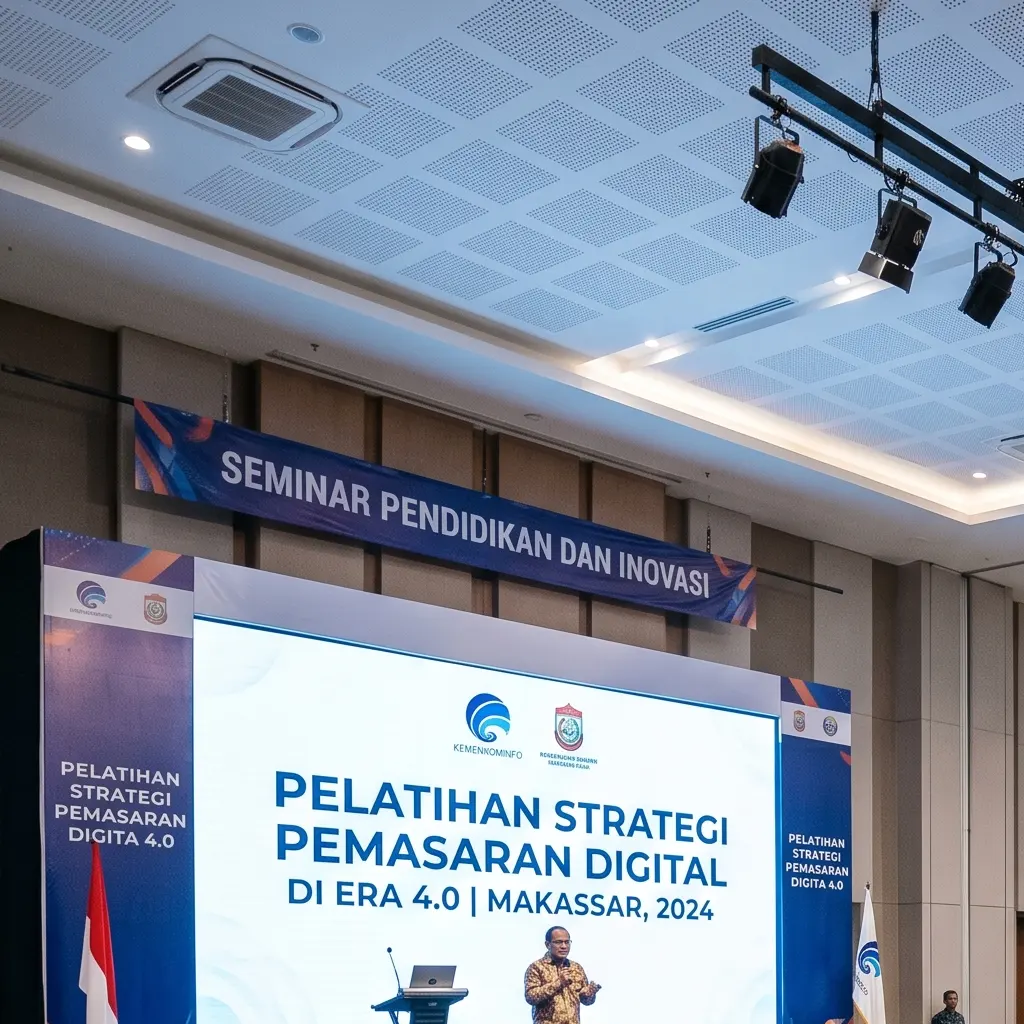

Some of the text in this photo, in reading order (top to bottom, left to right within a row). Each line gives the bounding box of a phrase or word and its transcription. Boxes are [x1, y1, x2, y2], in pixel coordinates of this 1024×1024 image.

[221, 451, 710, 599] SEMINAR PENDIDIKAN DAN INOVASI
[453, 743, 523, 760] KEMENKOMINFO
[61, 761, 180, 787] PELATIHAN
[70, 783, 171, 806] STRATEGI
[55, 803, 186, 828] PEMASARAN
[275, 770, 728, 846] PELATIHAN STRATEGI
[68, 826, 175, 849] DIGITA 4.0
[788, 833, 845, 849] PELATIHAN
[277, 823, 728, 888] PEMASARAN DIGITAL
[792, 848, 841, 862] STRATEGI
[785, 862, 849, 877] PEMASARAN
[791, 876, 844, 891] DIGITA 4.0
[288, 878, 323, 905] DI
[336, 880, 403, 909] ERA
[412, 884, 460, 911] 4.0
[487, 888, 649, 922] MAKASSAR,
[656, 897, 714, 921] 2024
